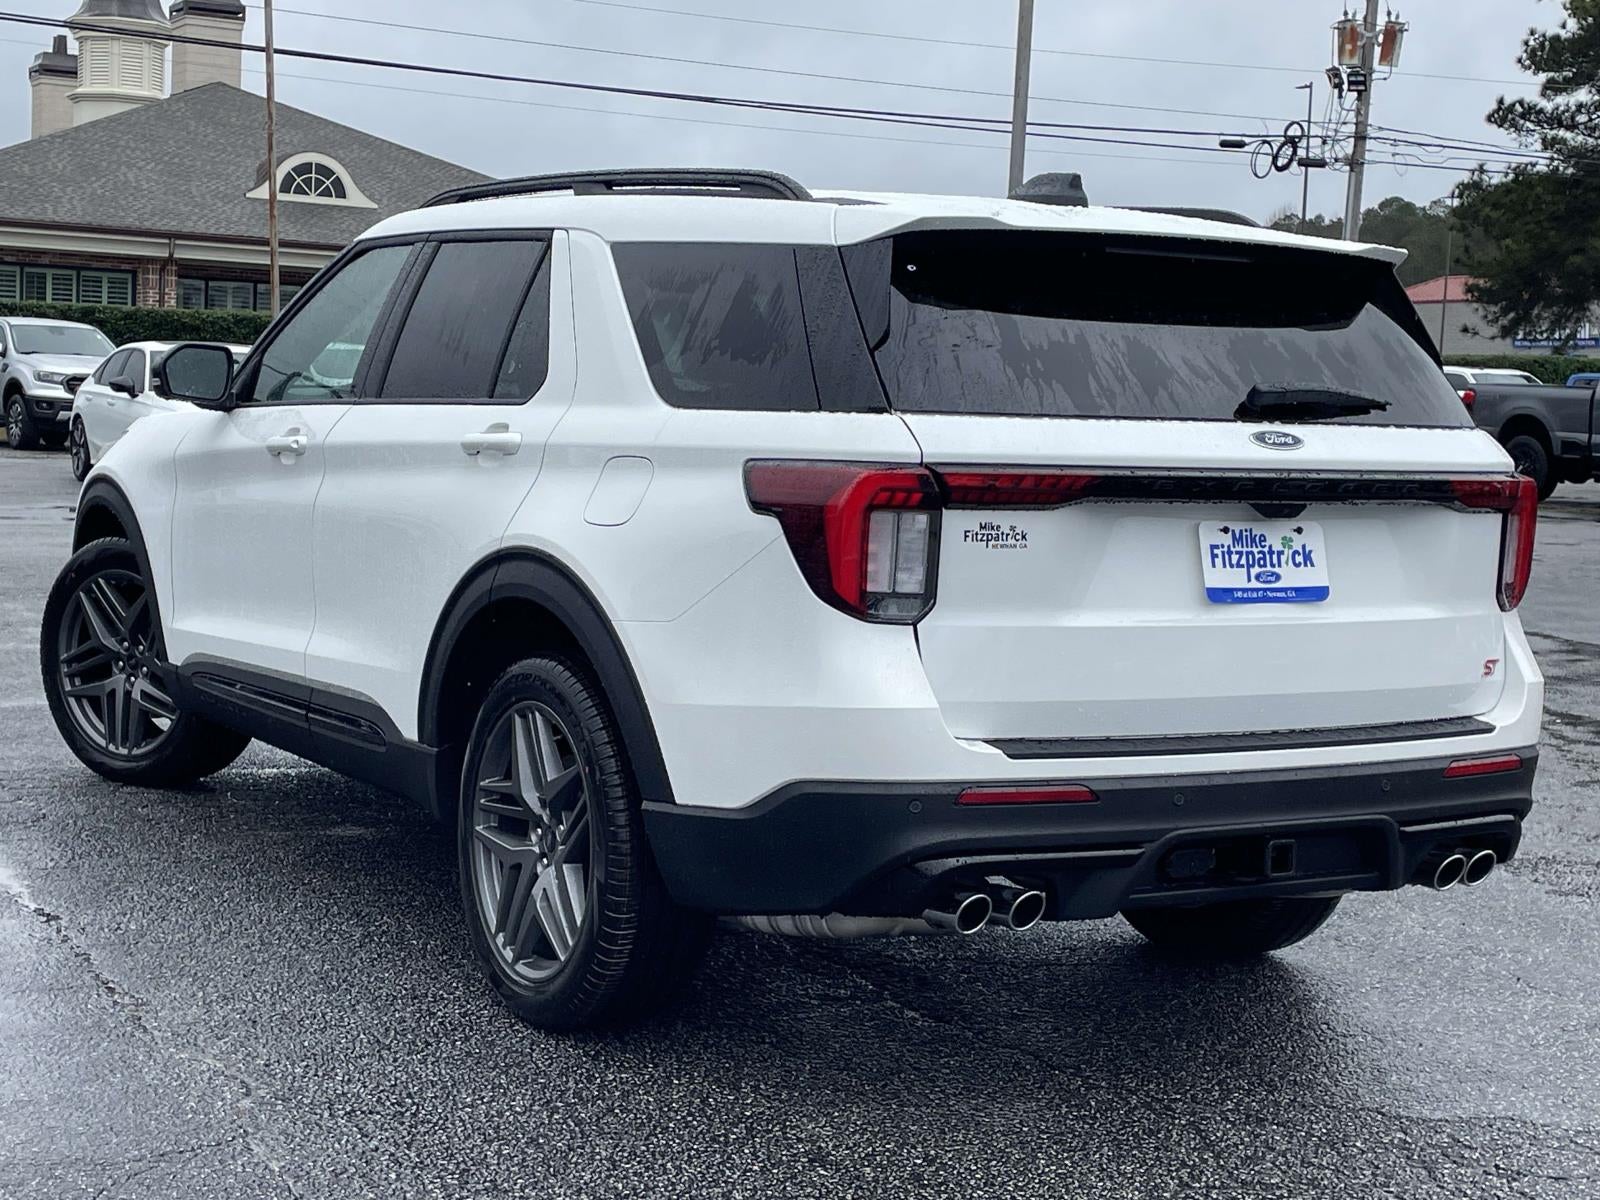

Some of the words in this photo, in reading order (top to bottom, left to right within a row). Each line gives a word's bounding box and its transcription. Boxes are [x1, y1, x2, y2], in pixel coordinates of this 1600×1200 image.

[1264, 432, 1295, 444] Ford
[979, 521, 1001, 532] Mike
[963, 530, 1028, 549] Fitzpatrick
[1231, 528, 1267, 549] Mike
[1209, 543, 1315, 583] Fitzpatrick
[1259, 572, 1277, 582] Ford
[1484, 658, 1500, 676] ST
